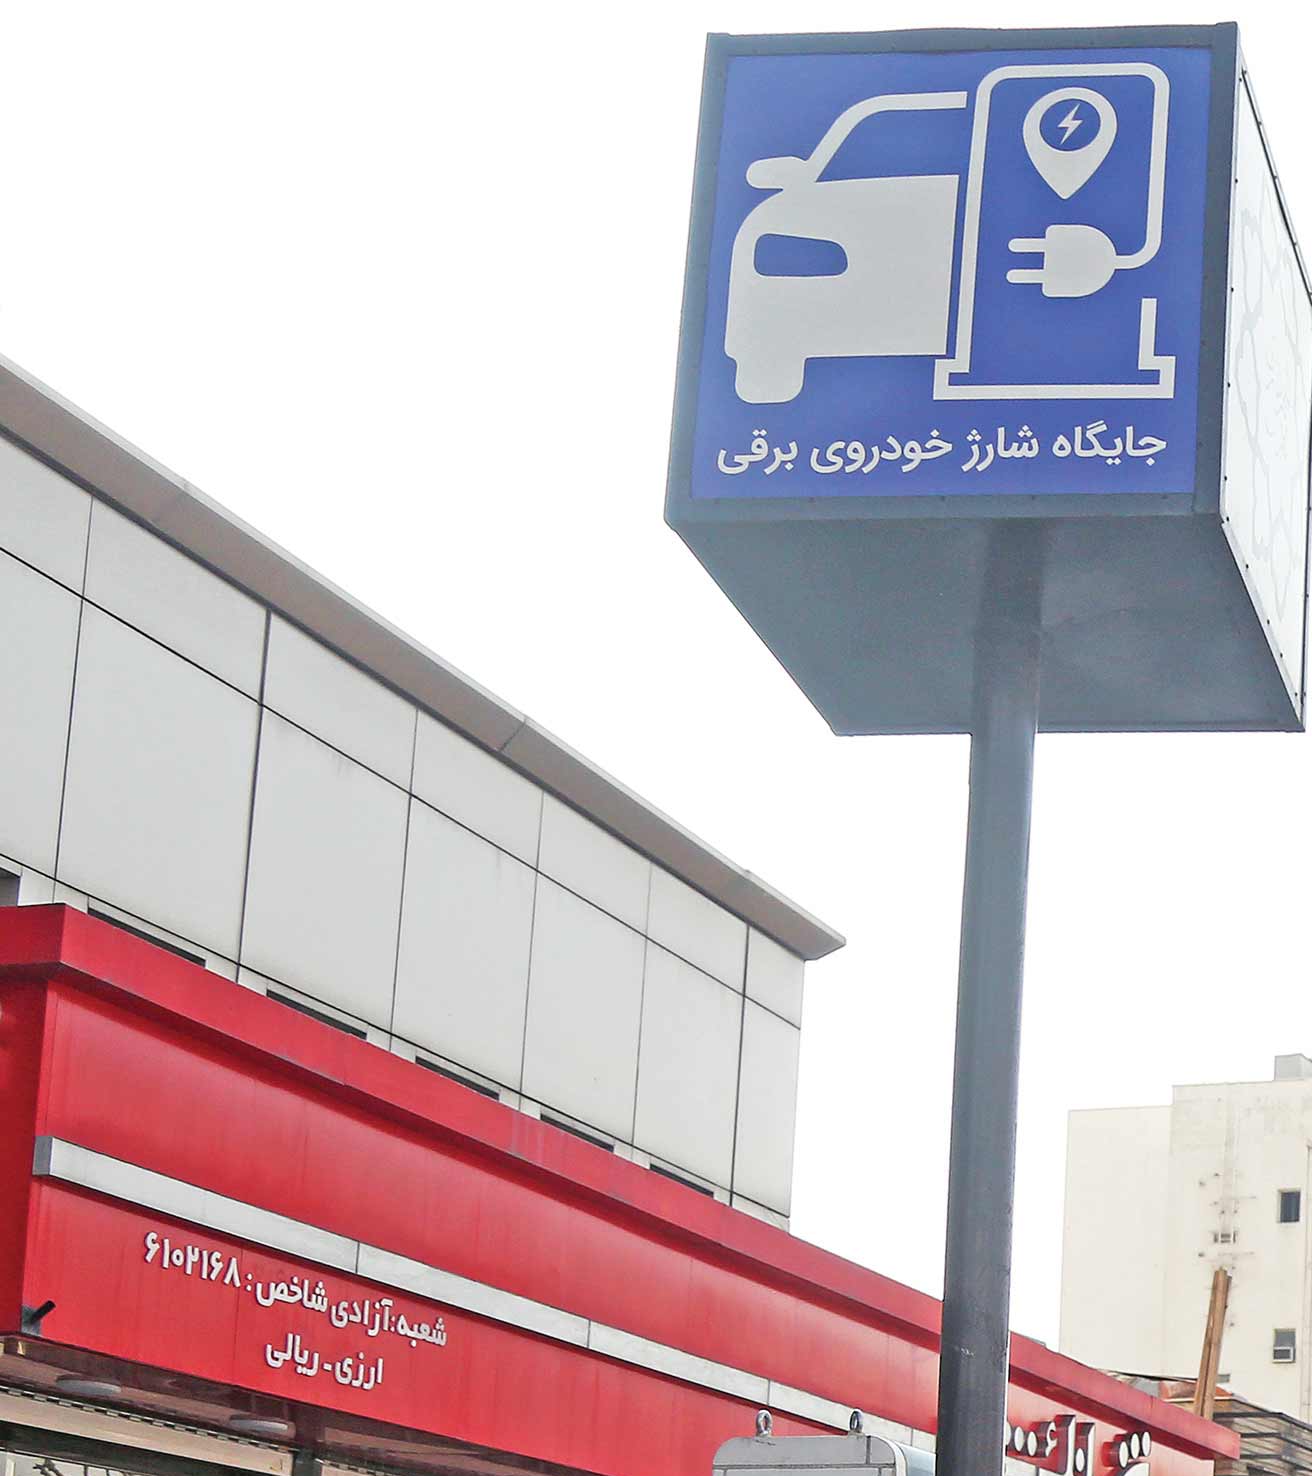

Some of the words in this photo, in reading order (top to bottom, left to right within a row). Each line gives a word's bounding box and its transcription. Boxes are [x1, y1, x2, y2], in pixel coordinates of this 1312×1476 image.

[717, 428, 798, 475] برقی
[810, 428, 952, 474] خودروی
[962, 425, 1040, 472] شارژ
[1052, 420, 1167, 466] جایگاه
[265, 1333, 319, 1377] ریالی
[335, 1353, 384, 1390] ارزی
